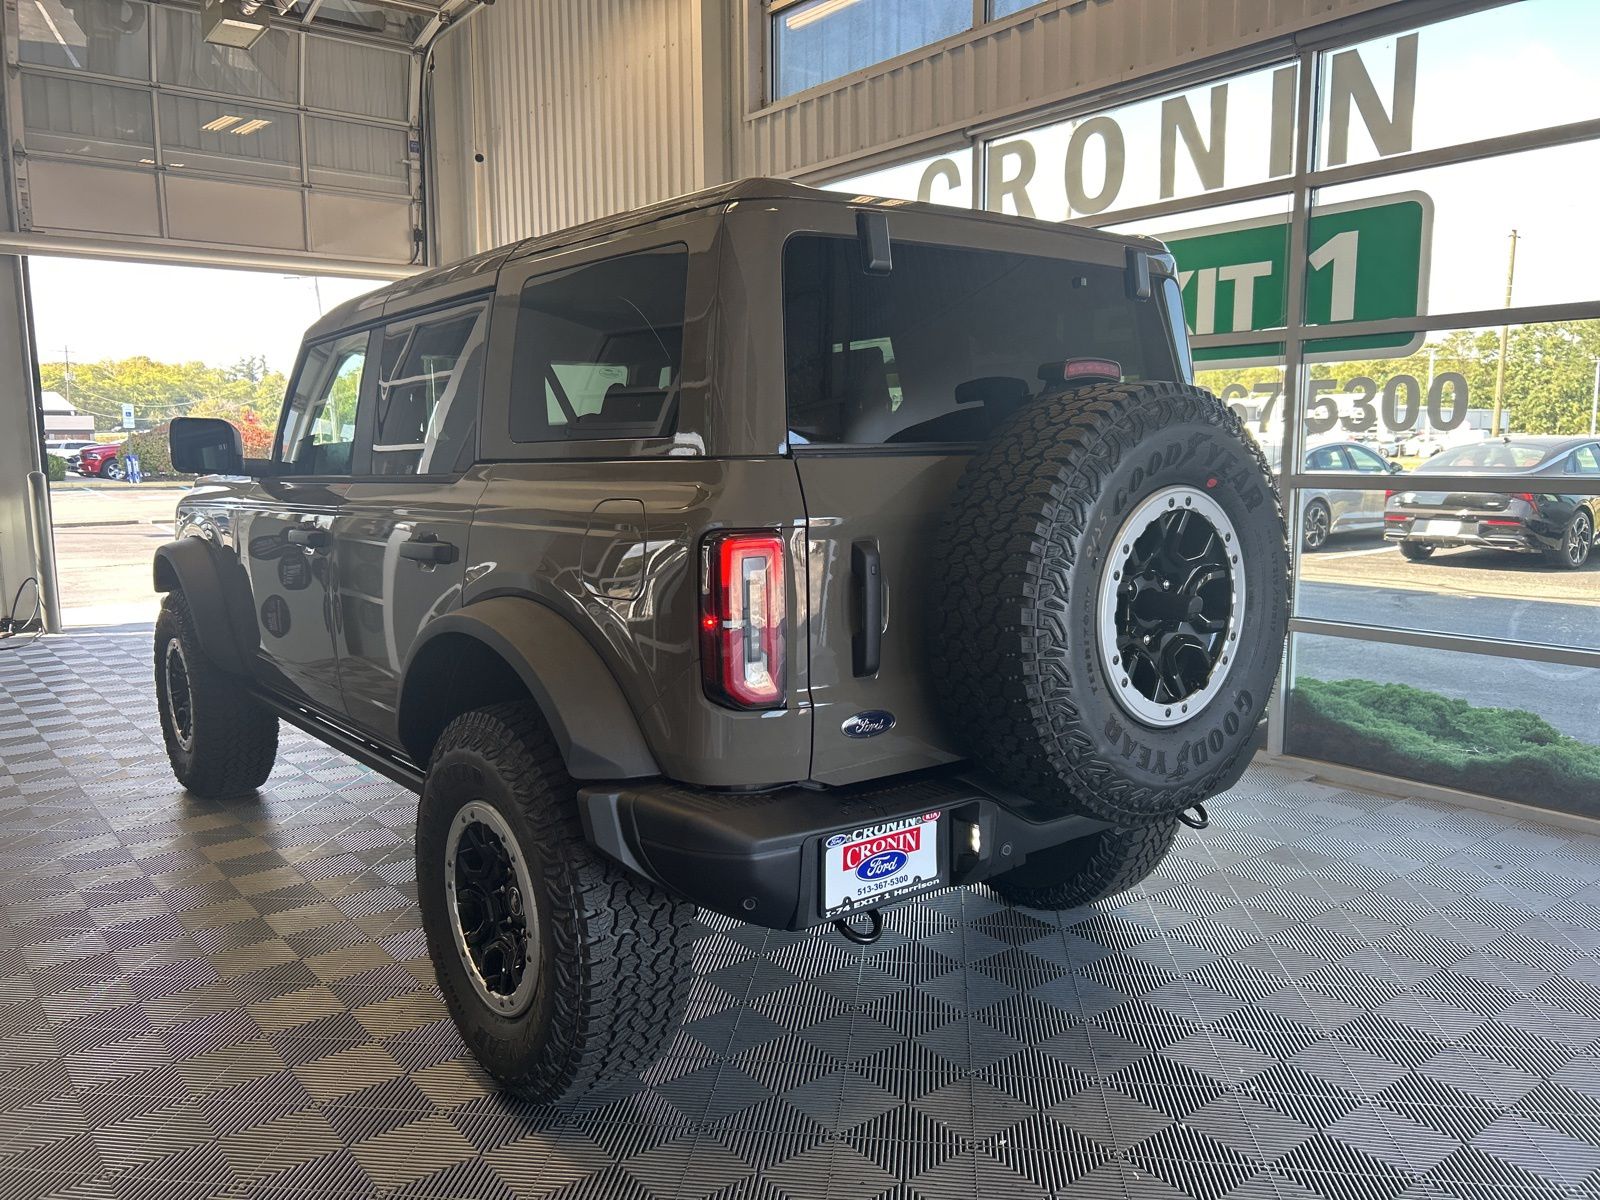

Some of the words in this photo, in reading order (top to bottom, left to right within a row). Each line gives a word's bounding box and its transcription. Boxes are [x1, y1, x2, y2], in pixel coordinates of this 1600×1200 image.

[917, 32, 1419, 219] CRONIN
[1308, 230, 1359, 322] 1
[855, 717, 884, 733] Ford
[1105, 690, 1253, 782] GOODYEAR
[846, 830, 918, 868] CRONIN
[867, 855, 898, 876] Ford
[825, 905, 850, 919] I-74
[853, 896, 880, 909] EXIT
[894, 879, 940, 896] Harrison
[857, 875, 909, 896] 513-367-5300
